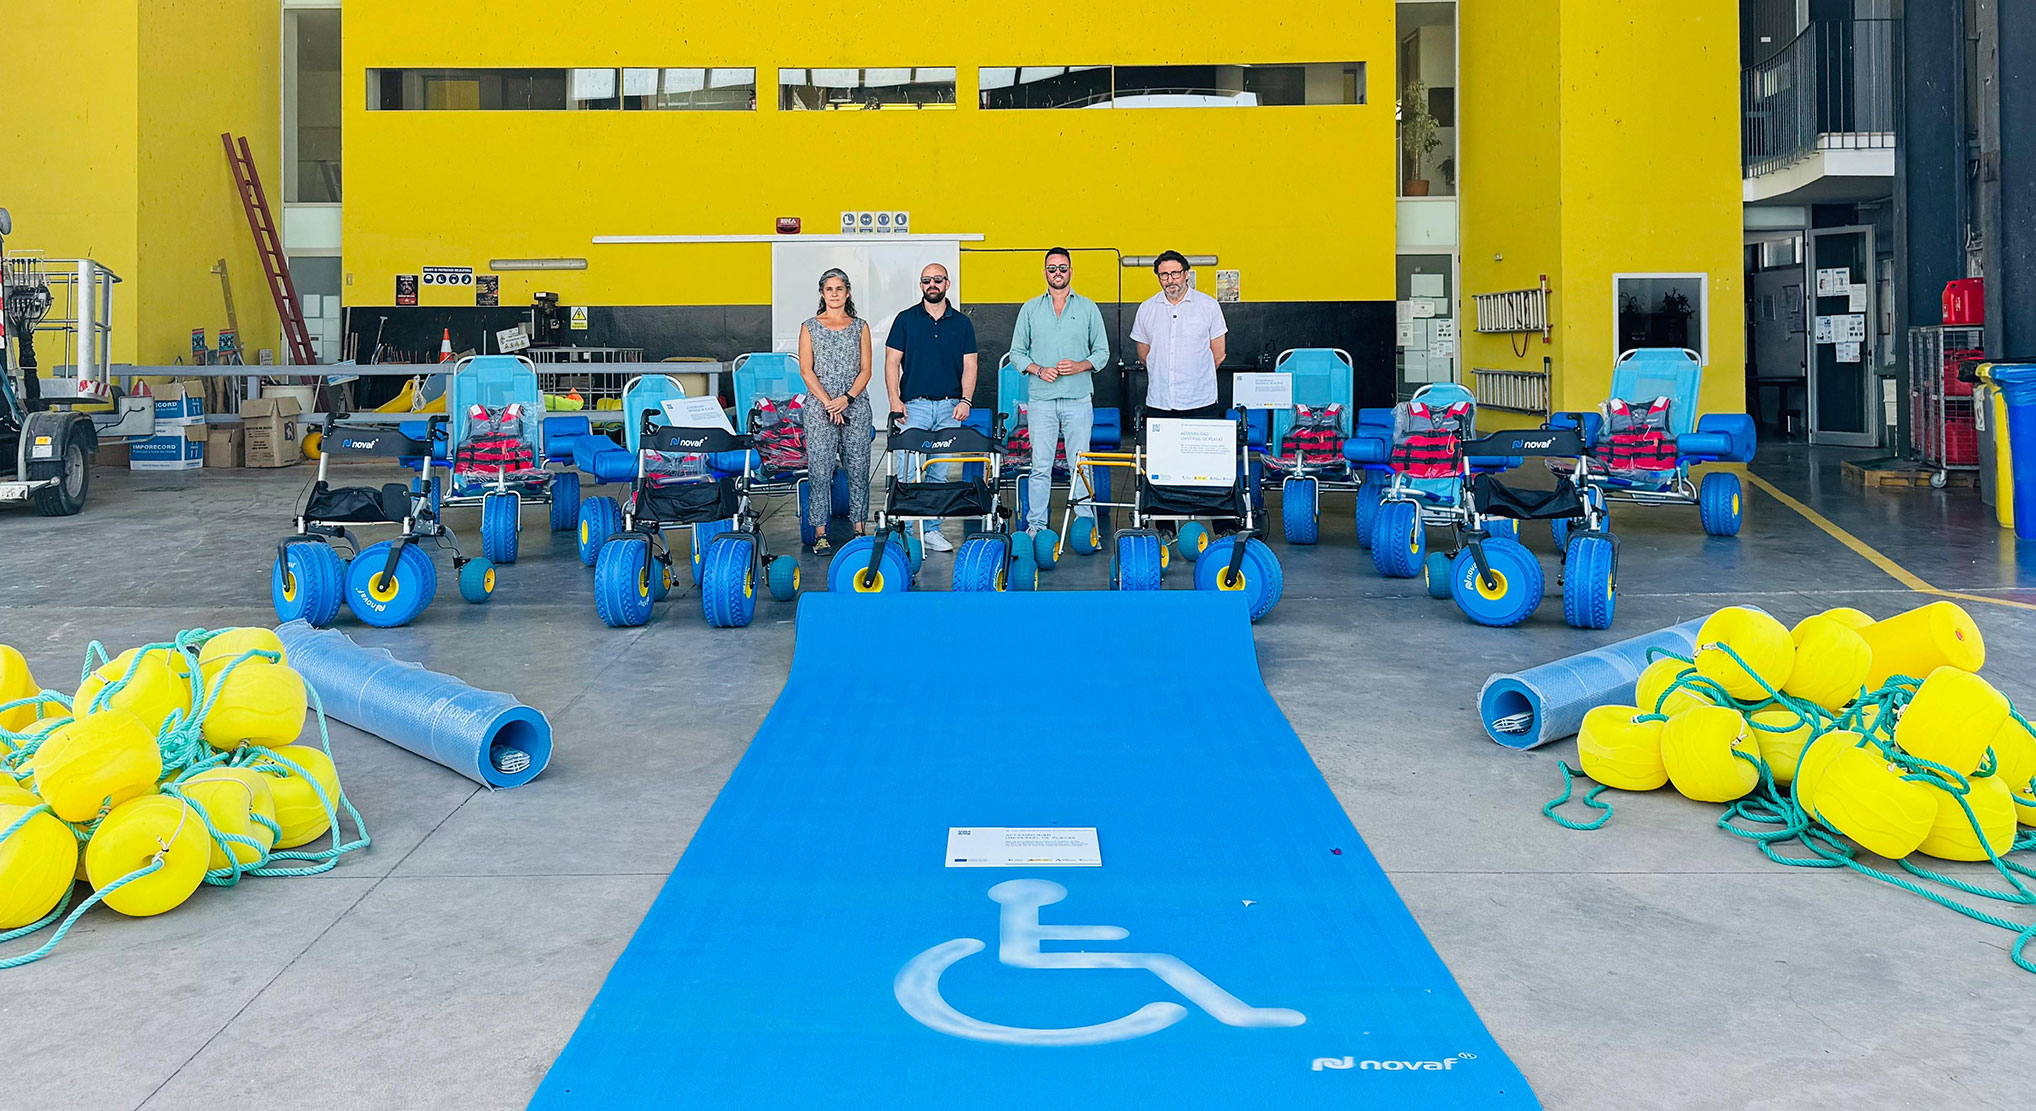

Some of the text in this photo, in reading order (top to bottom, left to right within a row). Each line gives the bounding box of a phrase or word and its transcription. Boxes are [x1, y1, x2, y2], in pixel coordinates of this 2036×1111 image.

[352, 440, 375, 449] novaf
[680, 438, 704, 447] novaf
[1524, 439, 1552, 449] novaf
[1360, 1057, 1458, 1071] novaf
